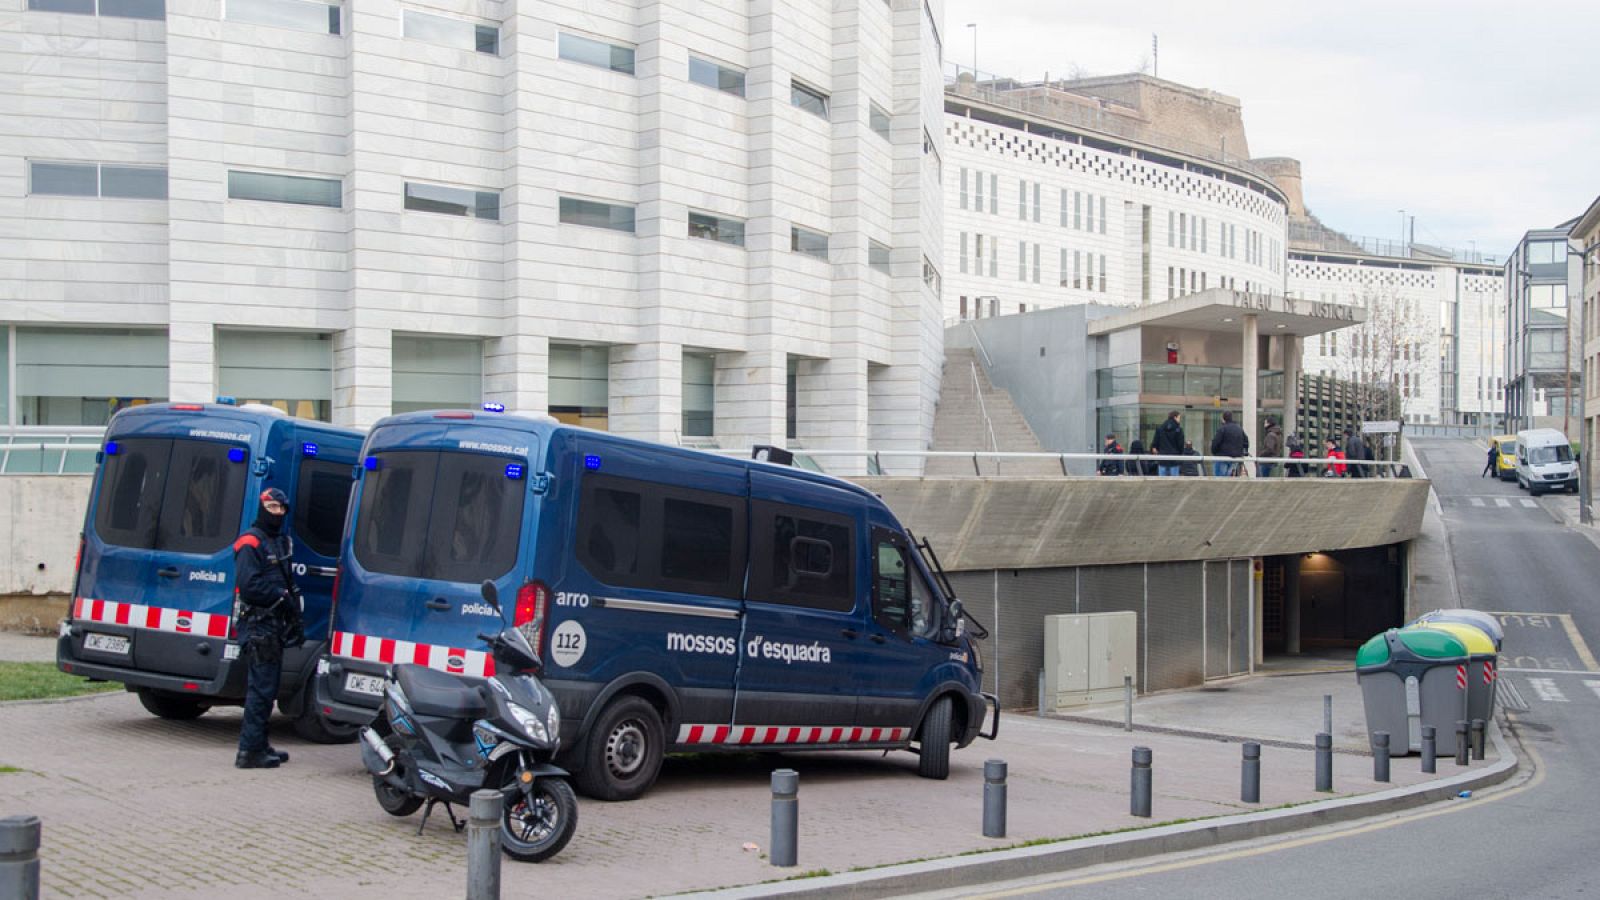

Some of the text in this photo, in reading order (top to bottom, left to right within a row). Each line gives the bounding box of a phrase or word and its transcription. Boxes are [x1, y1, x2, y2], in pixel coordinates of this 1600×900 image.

[1232, 291, 1272, 312] PALAU
[1283, 298, 1298, 314] DE
[189, 429, 251, 442] www.mossos.cat
[459, 440, 529, 456] www.mossos.cat
[189, 570, 217, 582] policia
[556, 591, 589, 608] arro
[461, 603, 493, 616] policia
[556, 633, 581, 649] 112
[667, 632, 831, 665] mossos d'esquadra
